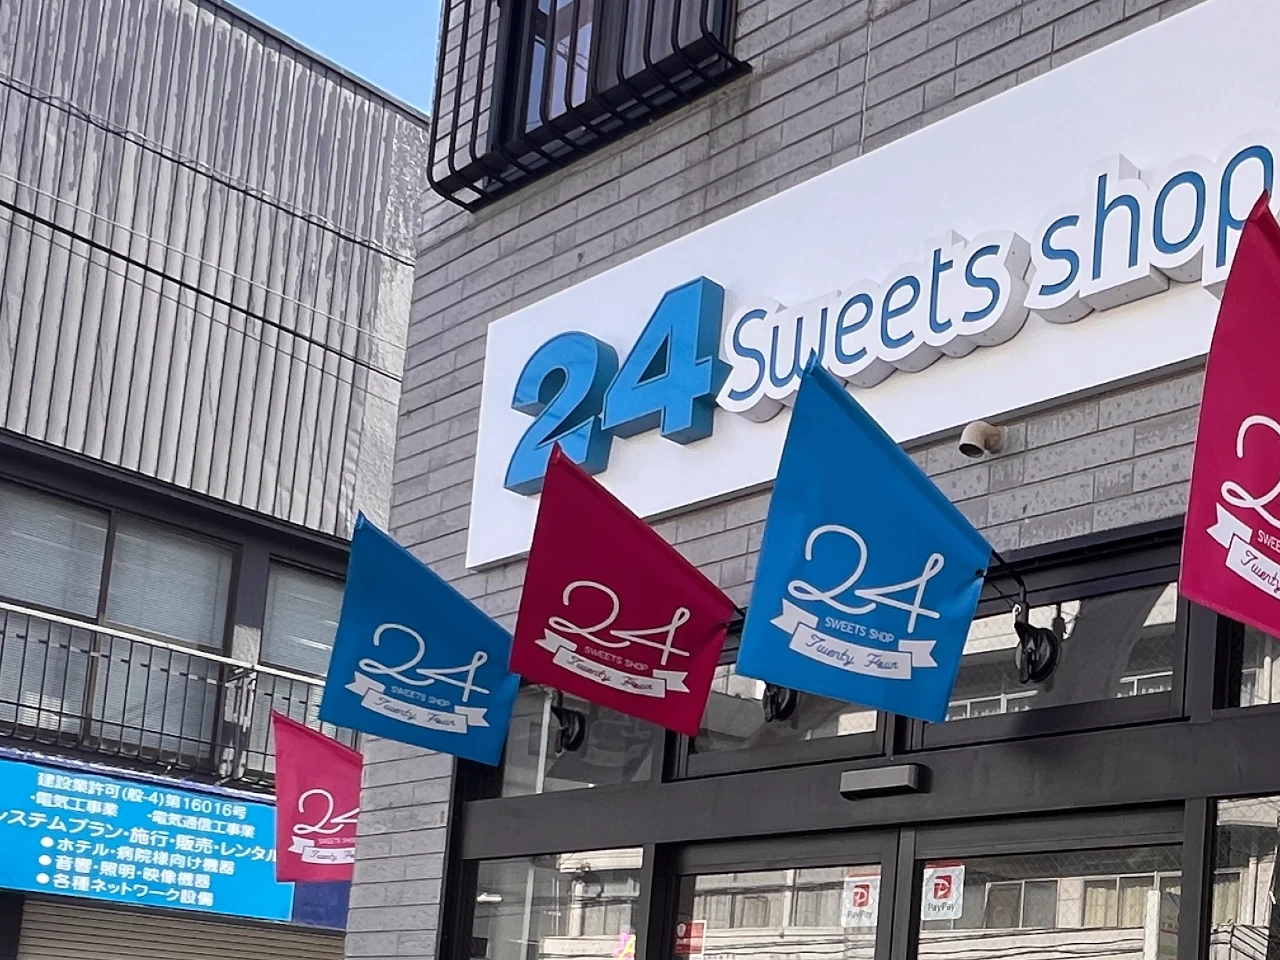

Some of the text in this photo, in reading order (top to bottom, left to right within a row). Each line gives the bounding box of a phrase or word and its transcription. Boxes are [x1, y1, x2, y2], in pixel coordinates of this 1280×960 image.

[505, 144, 1275, 493] 24 Sweets shop
[788, 524, 945, 634] 24
[549, 580, 691, 666] 24
[825, 616, 895, 644] SWEETS SHOP
[358, 623, 490, 703] 24
[584, 645, 650, 671] SWEETS SHOP
[805, 633, 900, 670] Twenty Four
[566, 654, 612, 682] Twenty
[373, 696, 417, 721] Twenty
[390, 685, 452, 708] SWEETS SHOP
[847, 909, 874, 920] PayPay
[927, 902, 955, 913] PayPay
